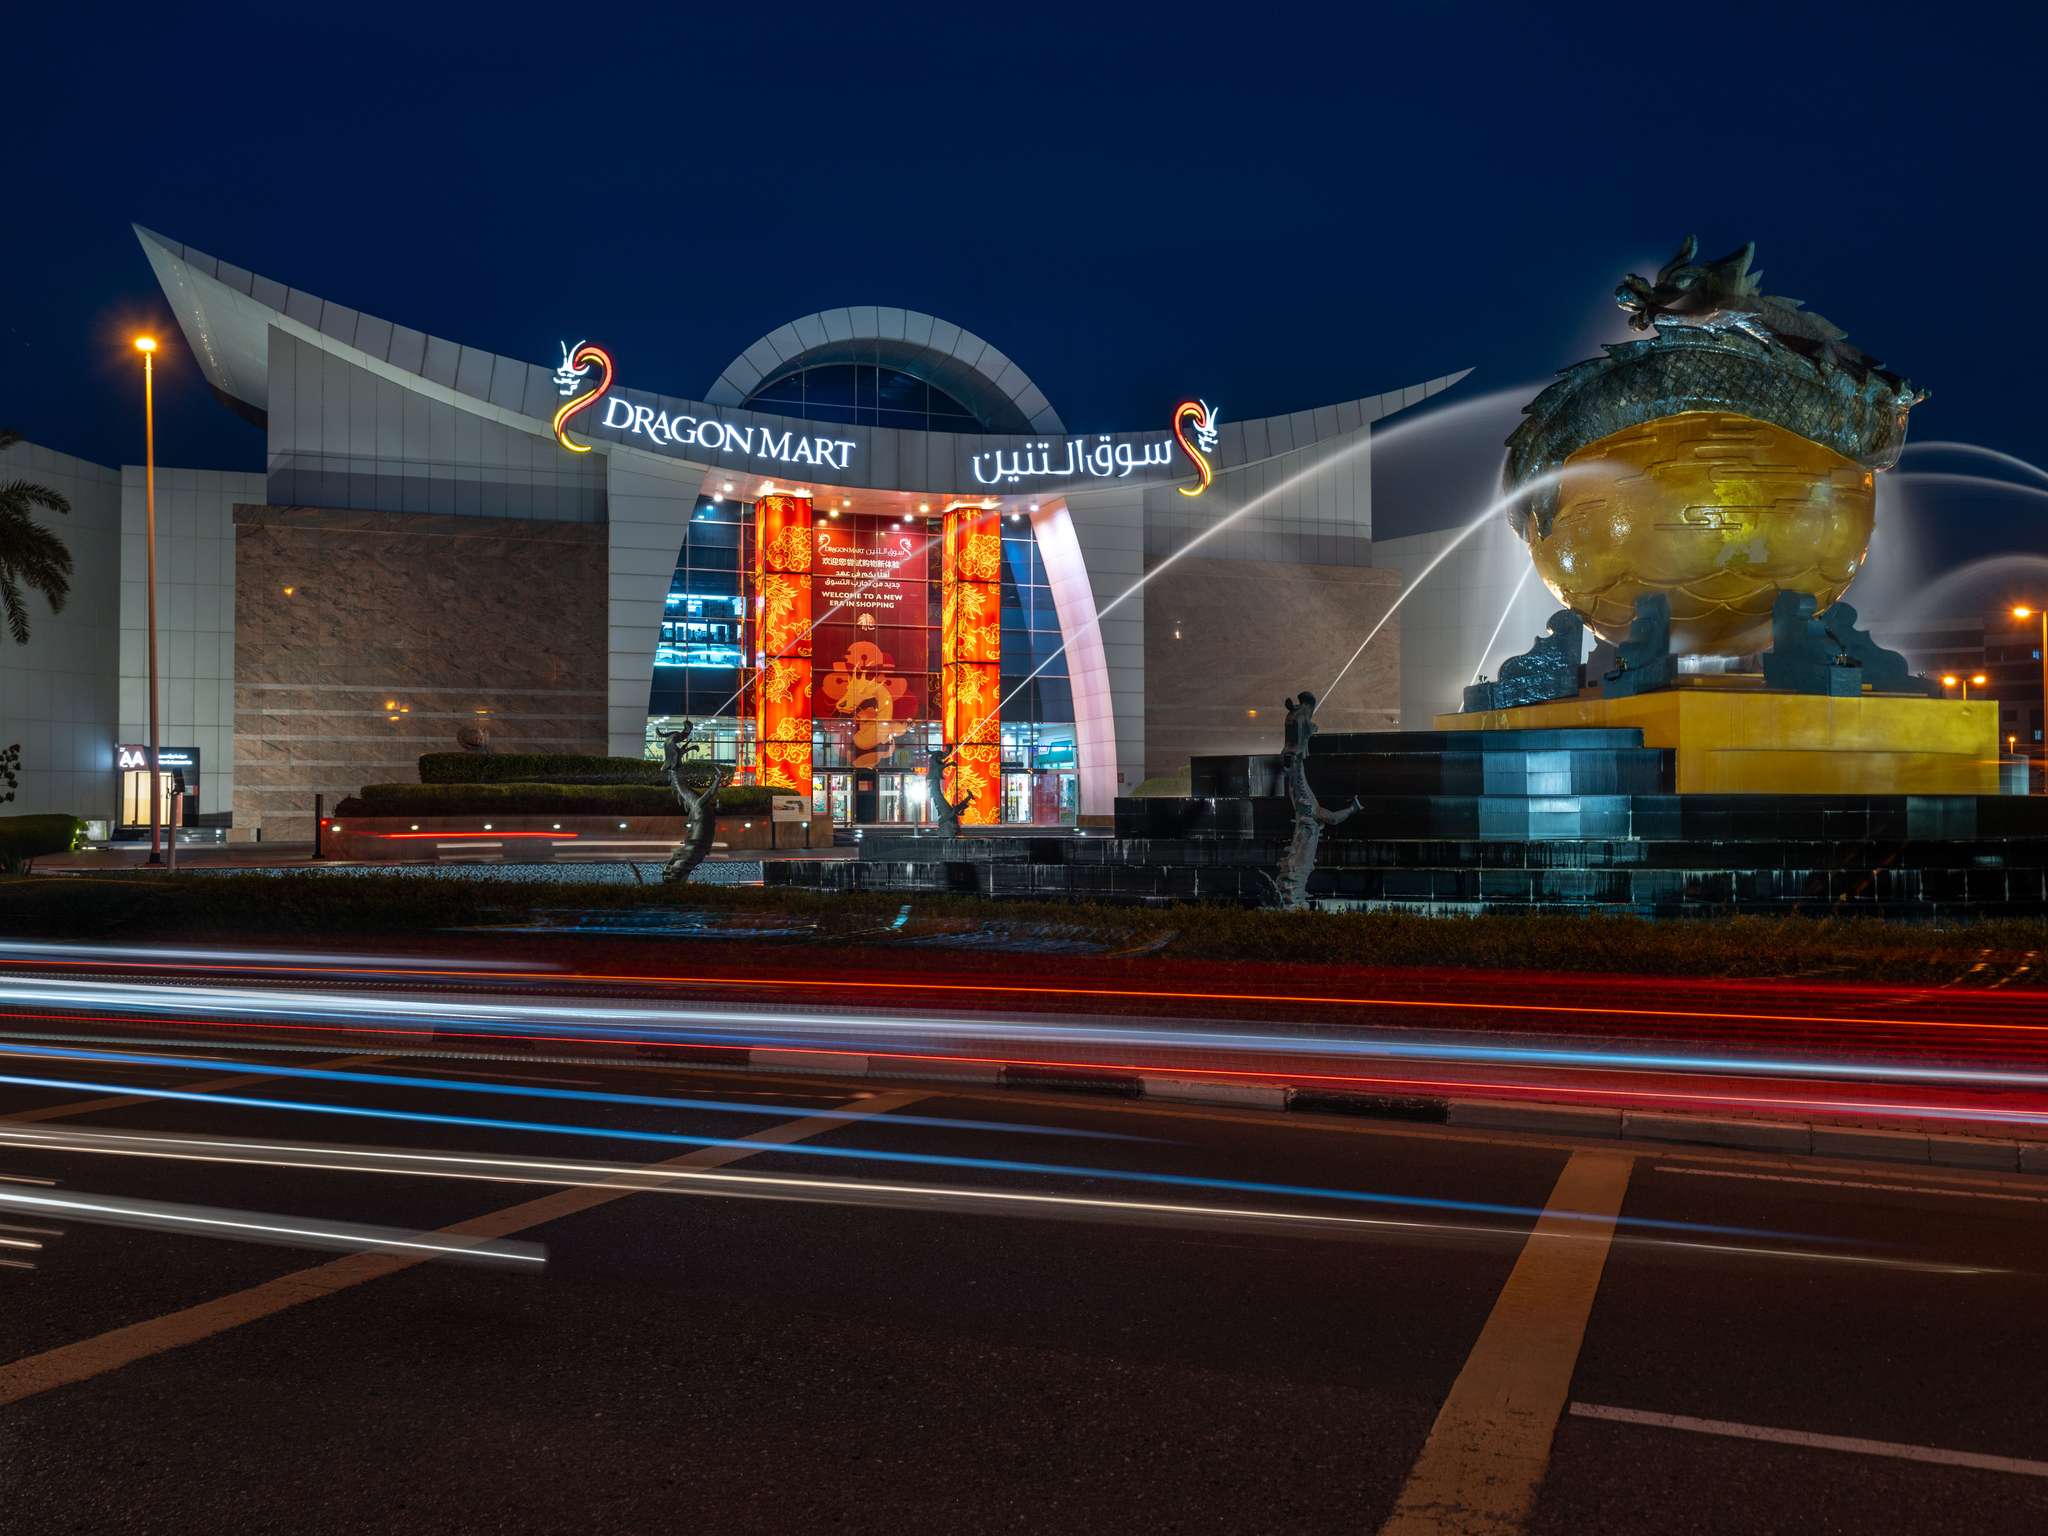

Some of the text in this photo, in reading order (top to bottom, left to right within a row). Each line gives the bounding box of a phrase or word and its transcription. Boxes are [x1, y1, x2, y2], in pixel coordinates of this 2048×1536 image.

[602, 396, 856, 470] DRAGON MART
[972, 435, 1173, 484] سوق التنين
[821, 591, 862, 600] WELCOME
